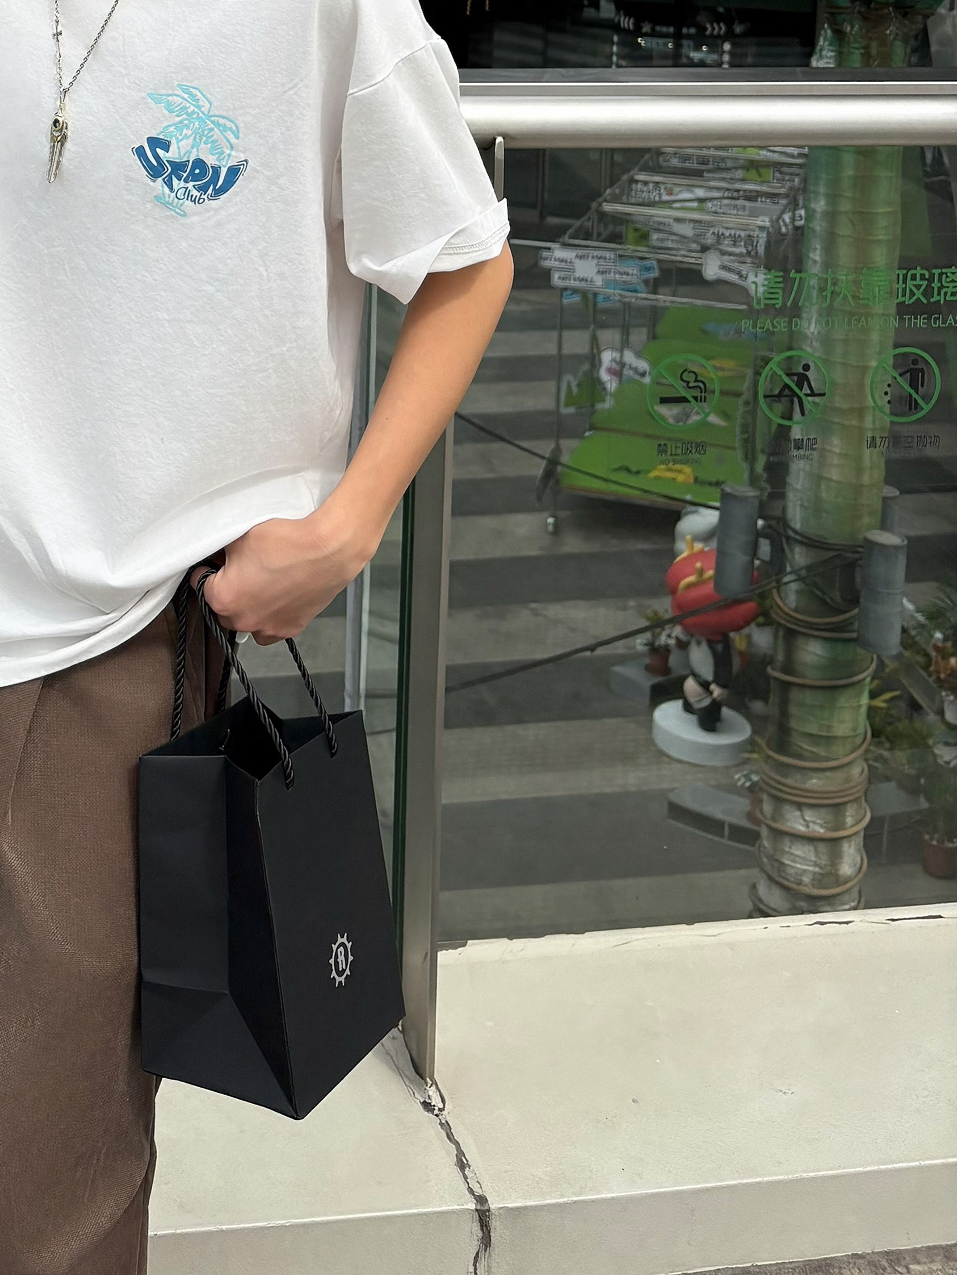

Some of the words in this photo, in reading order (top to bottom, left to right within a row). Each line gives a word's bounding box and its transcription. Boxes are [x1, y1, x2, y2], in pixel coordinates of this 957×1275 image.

[175, 186, 206, 205] Club
[741, 317, 787, 331] PLEASE
[904, 315, 928, 328] THE
[657, 441, 707, 456] 禁止吸烟
